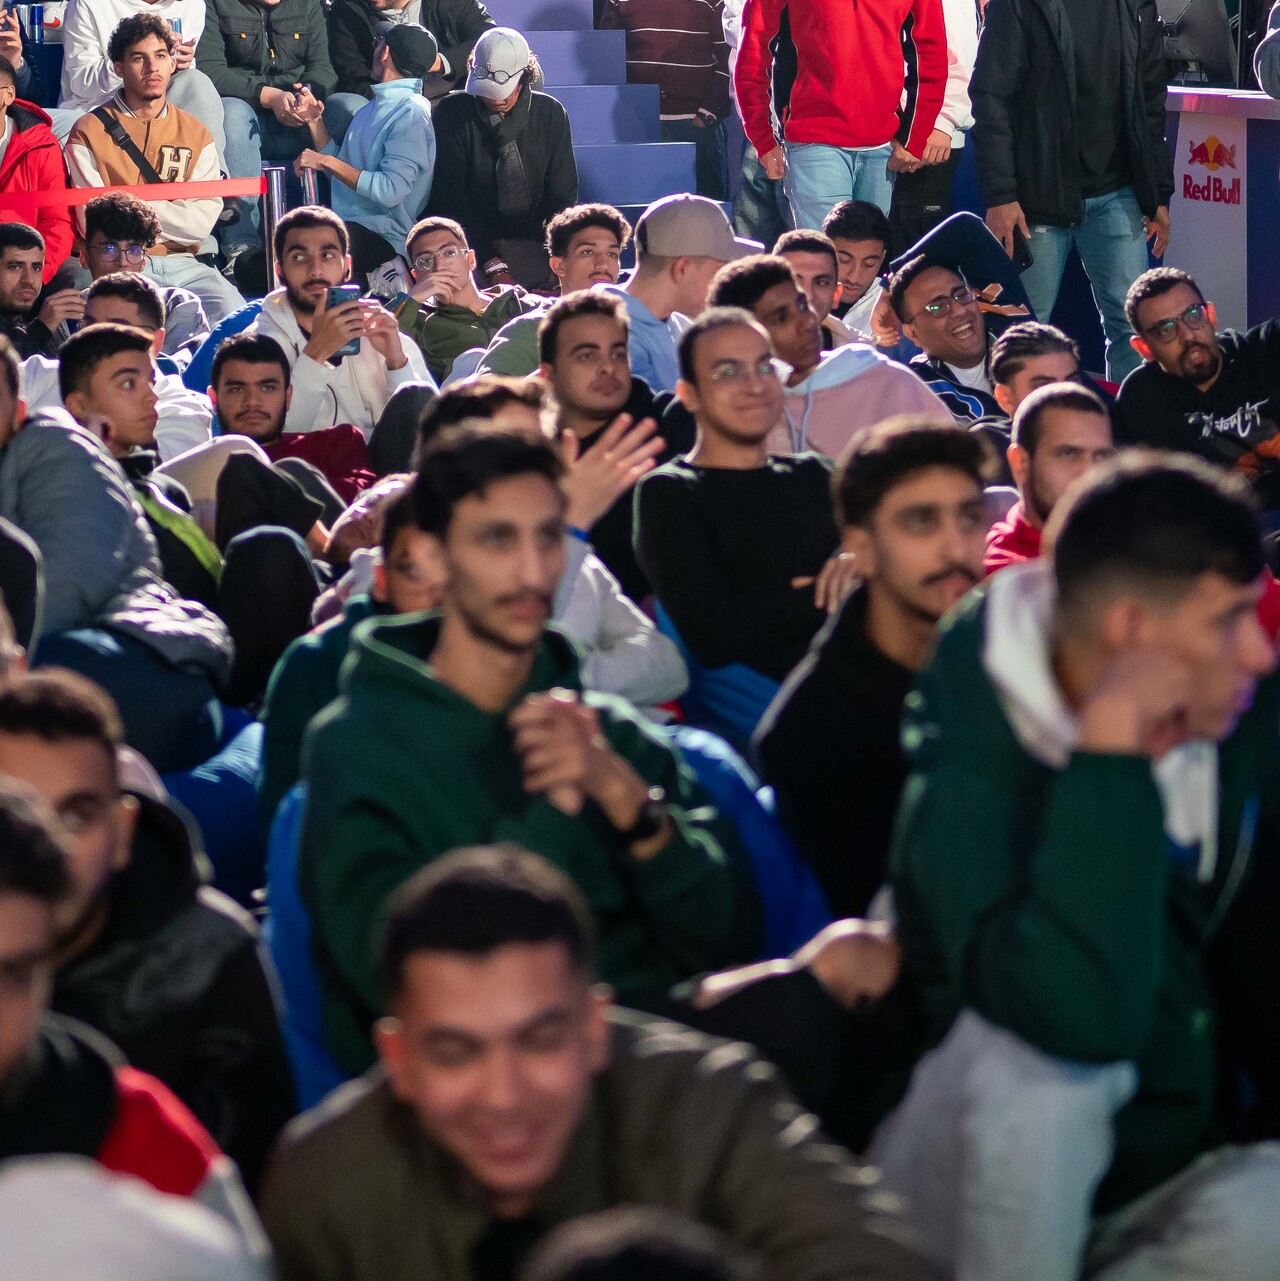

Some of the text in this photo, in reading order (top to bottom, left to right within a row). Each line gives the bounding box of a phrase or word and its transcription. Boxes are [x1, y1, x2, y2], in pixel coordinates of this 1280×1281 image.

[156, 145, 192, 182] H
[1183, 174, 1240, 205] Red Bull
